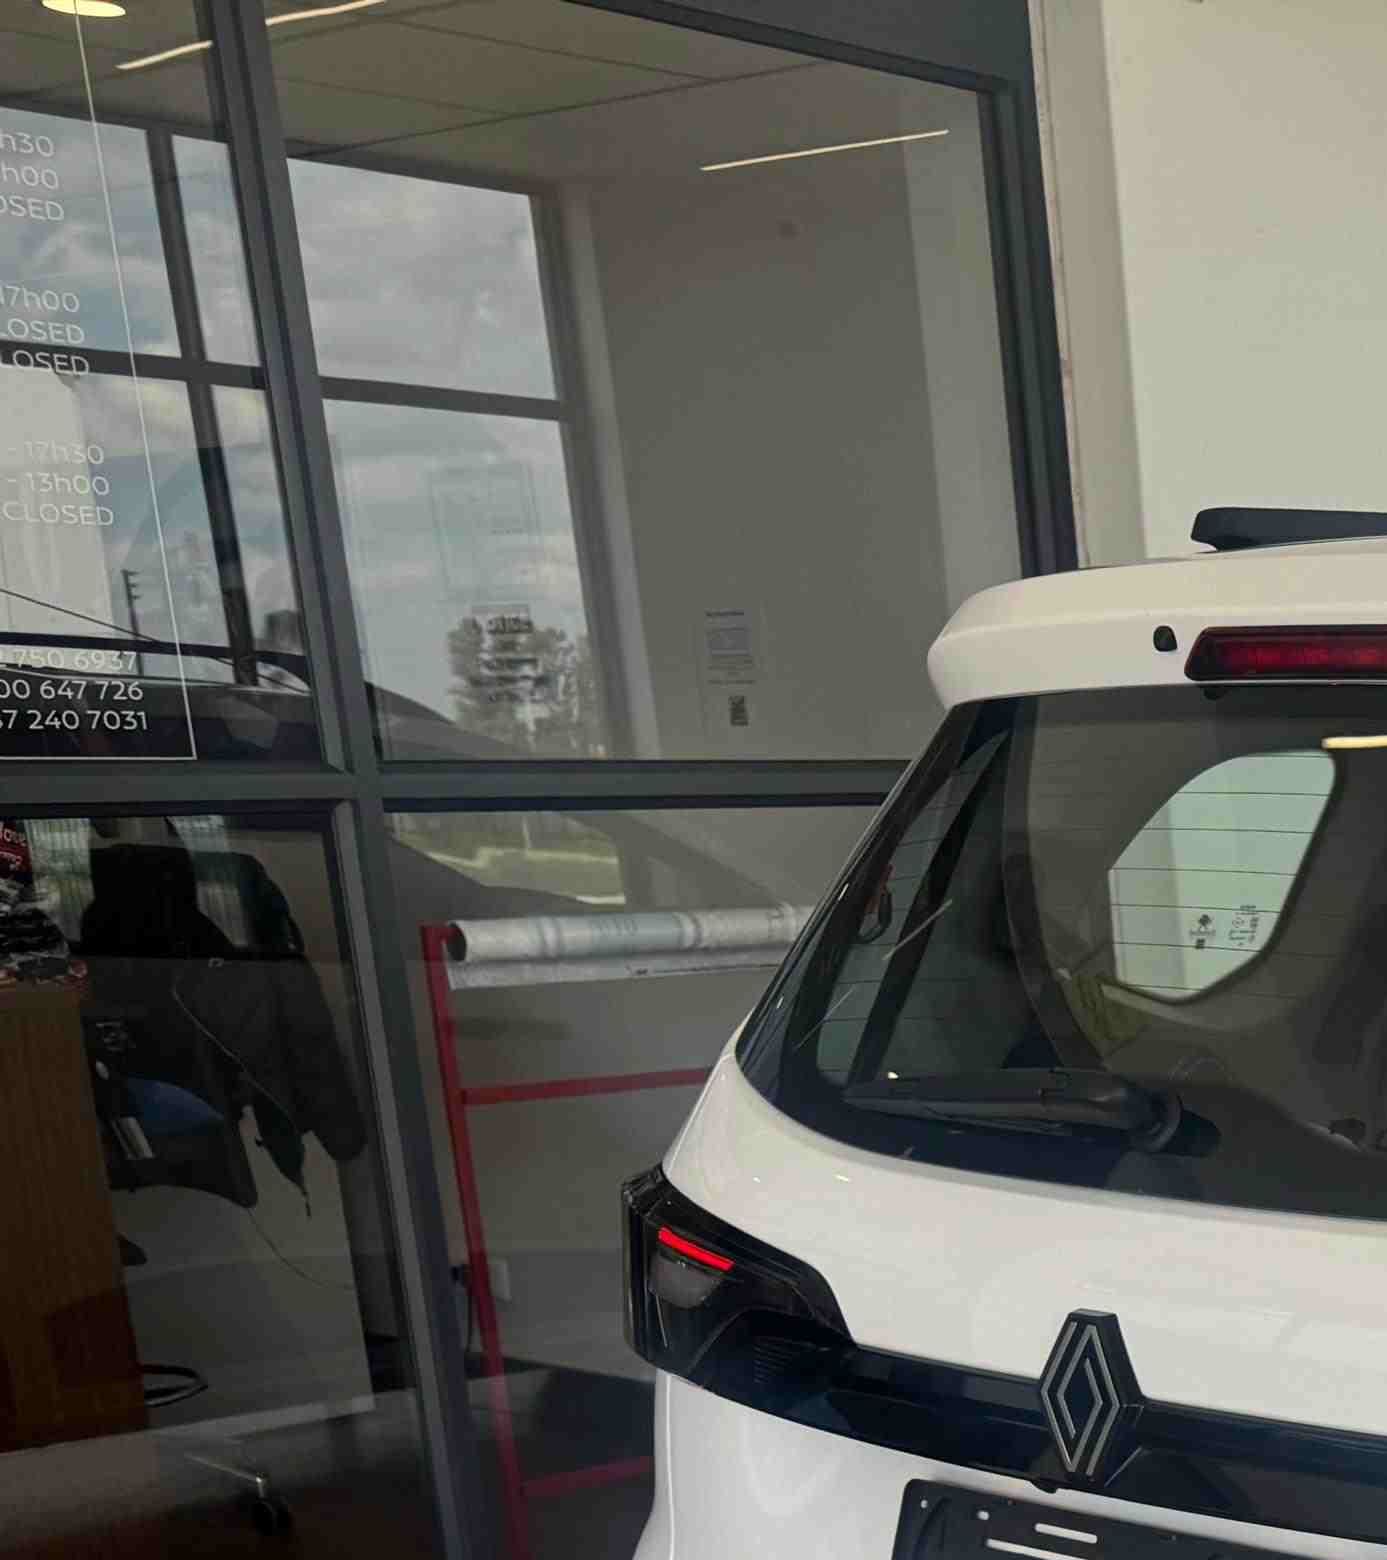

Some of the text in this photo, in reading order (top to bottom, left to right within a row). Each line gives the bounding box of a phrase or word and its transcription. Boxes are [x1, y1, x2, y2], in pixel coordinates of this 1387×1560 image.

[24, 471, 110, 496] 13h00
[3, 501, 114, 527] CLOSED
[74, 650, 138, 671] 6937
[39, 679, 87, 700] 647
[95, 680, 144, 701] 726
[26, 709, 80, 730] 240
[85, 709, 149, 731] 7031
